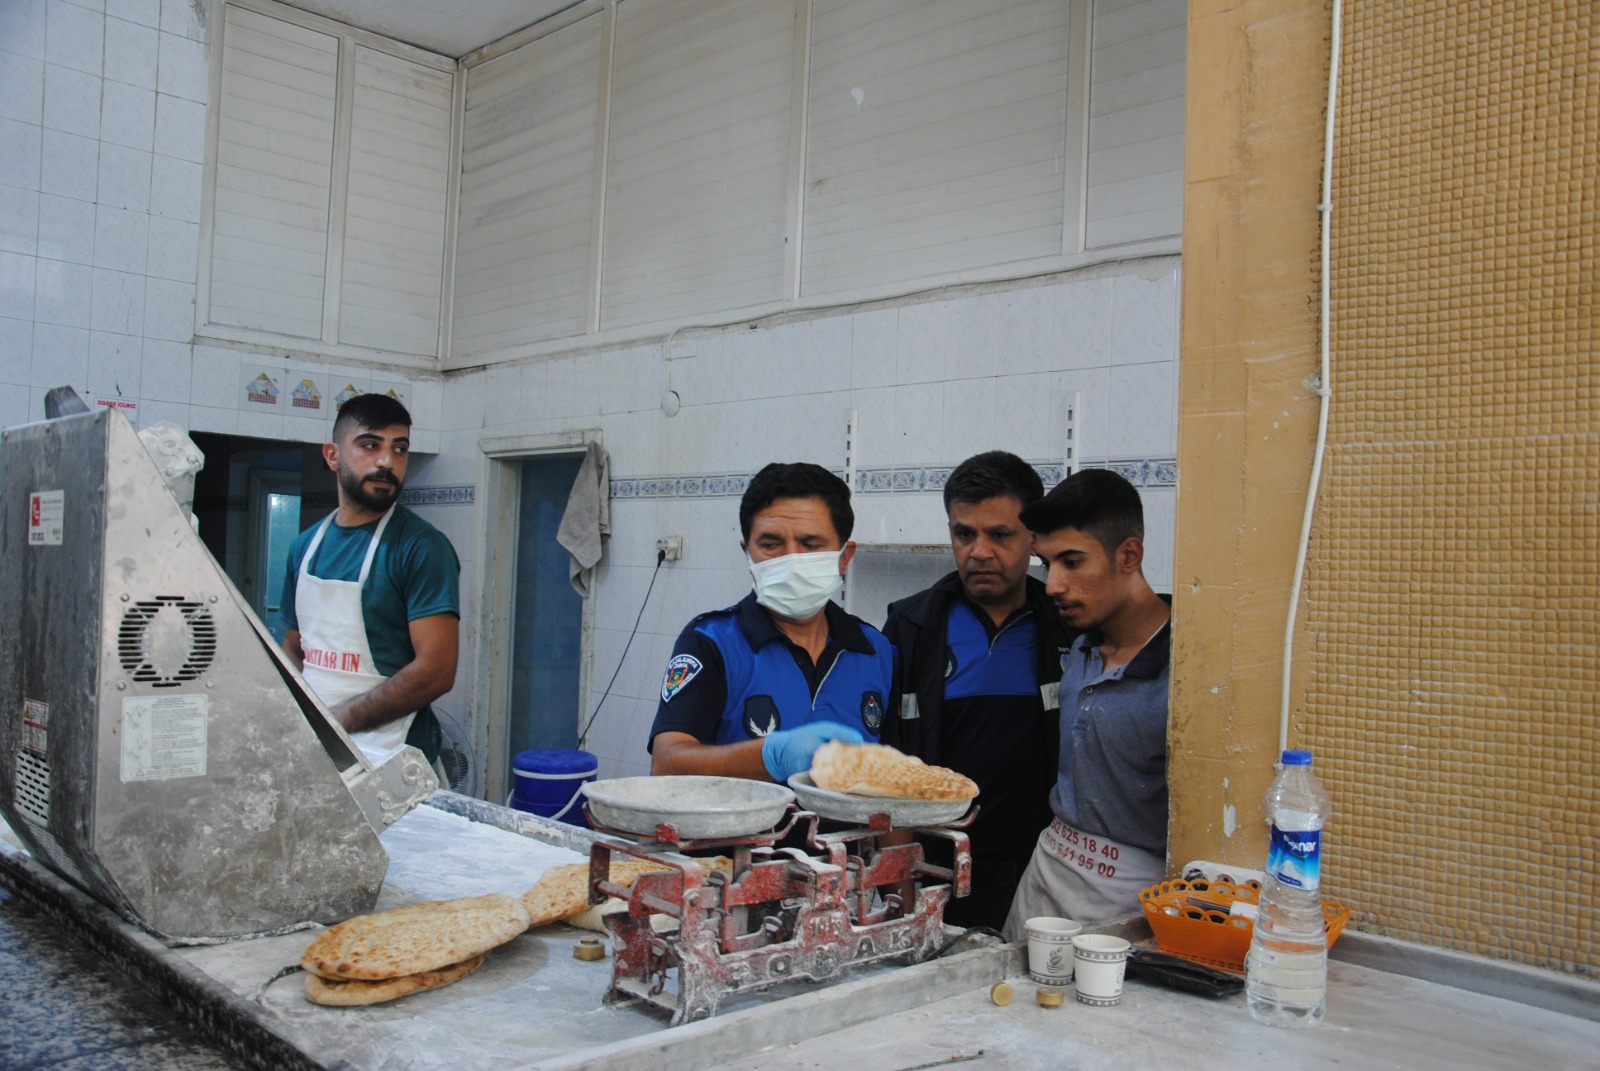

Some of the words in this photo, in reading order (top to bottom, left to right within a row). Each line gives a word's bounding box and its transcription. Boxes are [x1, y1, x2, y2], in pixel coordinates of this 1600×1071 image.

[341, 652, 361, 673] UN
[1057, 843, 1076, 861] 641
[1078, 854, 1094, 871] 95
[1097, 862, 1116, 878] 00
[1061, 825, 1079, 844] 625
[1082, 836, 1097, 853] 18
[1101, 844, 1119, 861] 40
